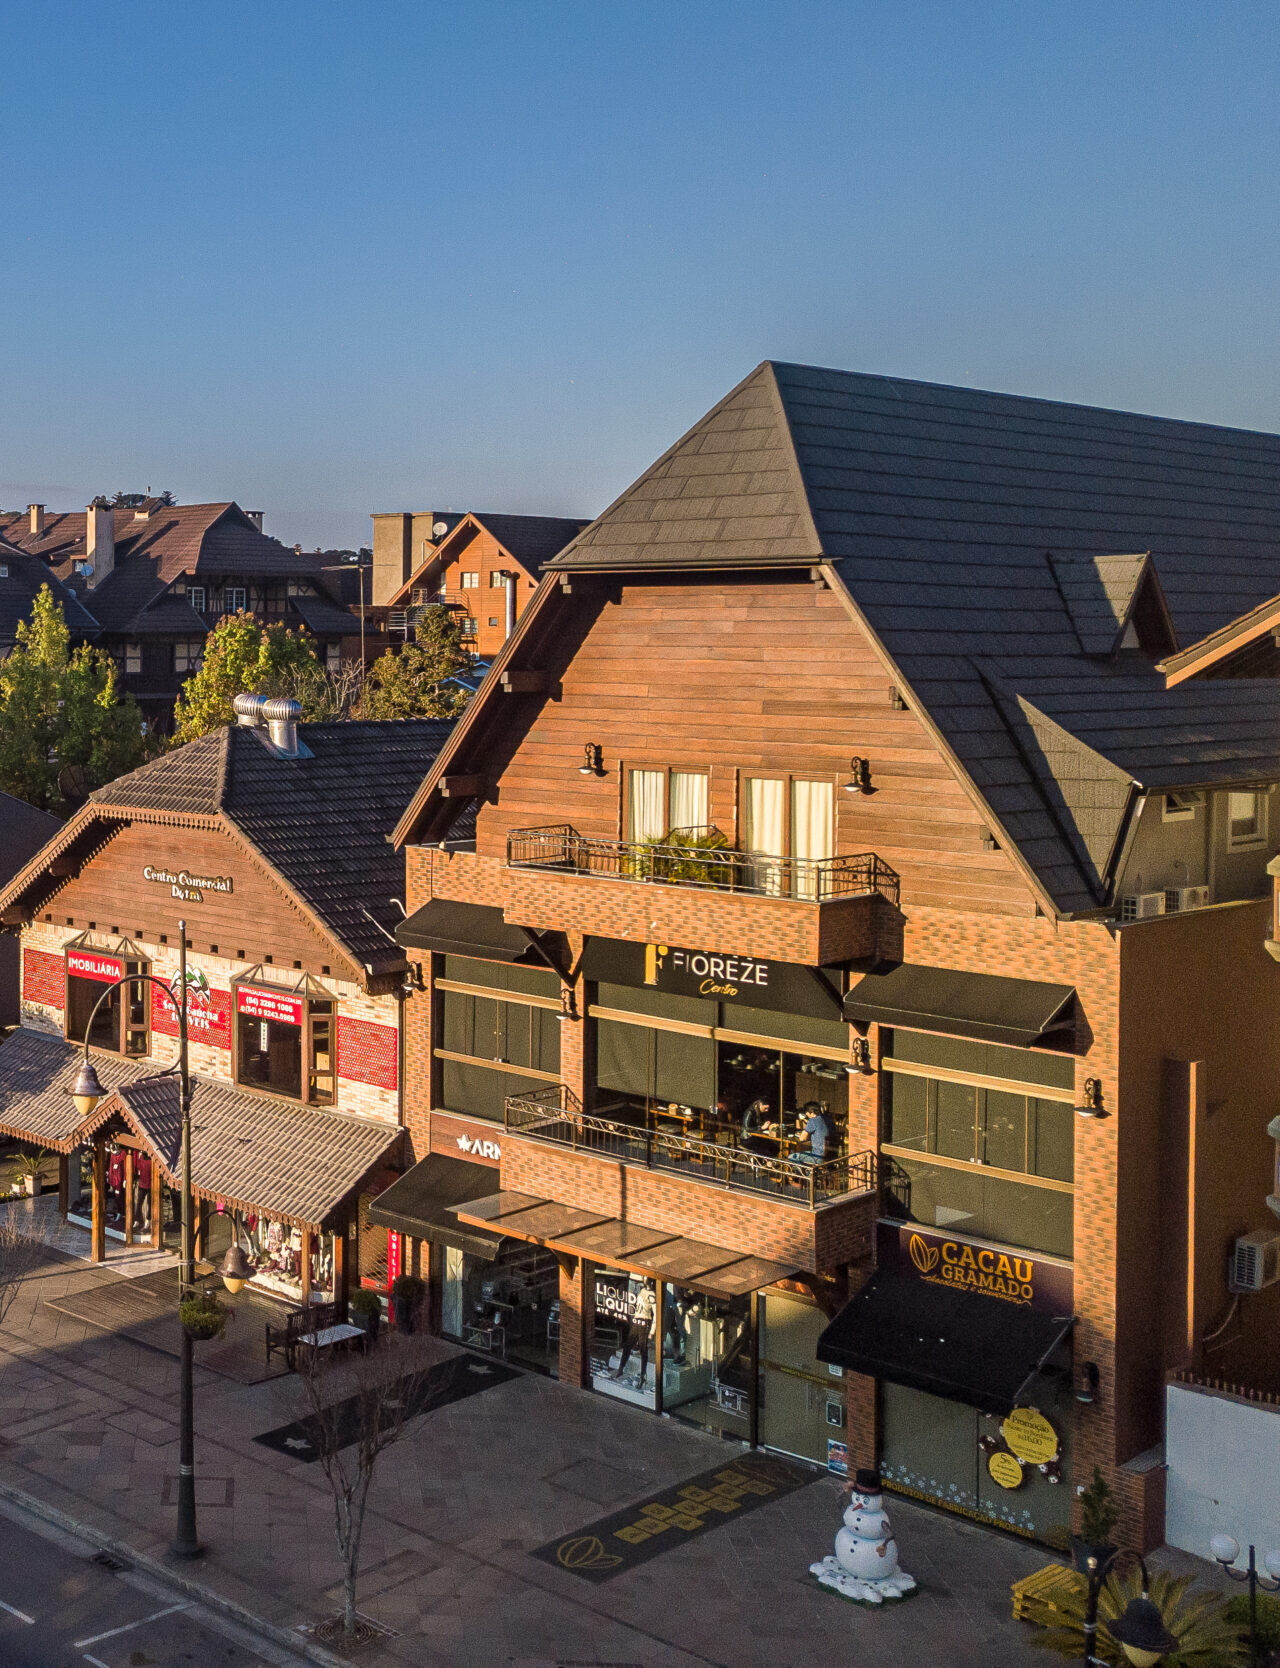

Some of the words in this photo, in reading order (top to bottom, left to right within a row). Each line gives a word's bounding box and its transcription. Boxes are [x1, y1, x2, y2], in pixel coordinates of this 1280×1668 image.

[143, 867, 177, 884] Centro
[178, 872, 231, 892] Comercial
[68, 957, 121, 978] IMOBILIÁRIA
[672, 951, 769, 986] FIOREZE
[699, 978, 739, 996] Centro
[941, 1241, 1034, 1283] CACAU
[941, 1263, 1034, 1300] GRAMADO
[880, 1478, 925, 1501] PRODUTOS
[924, 1493, 937, 1506] DE
